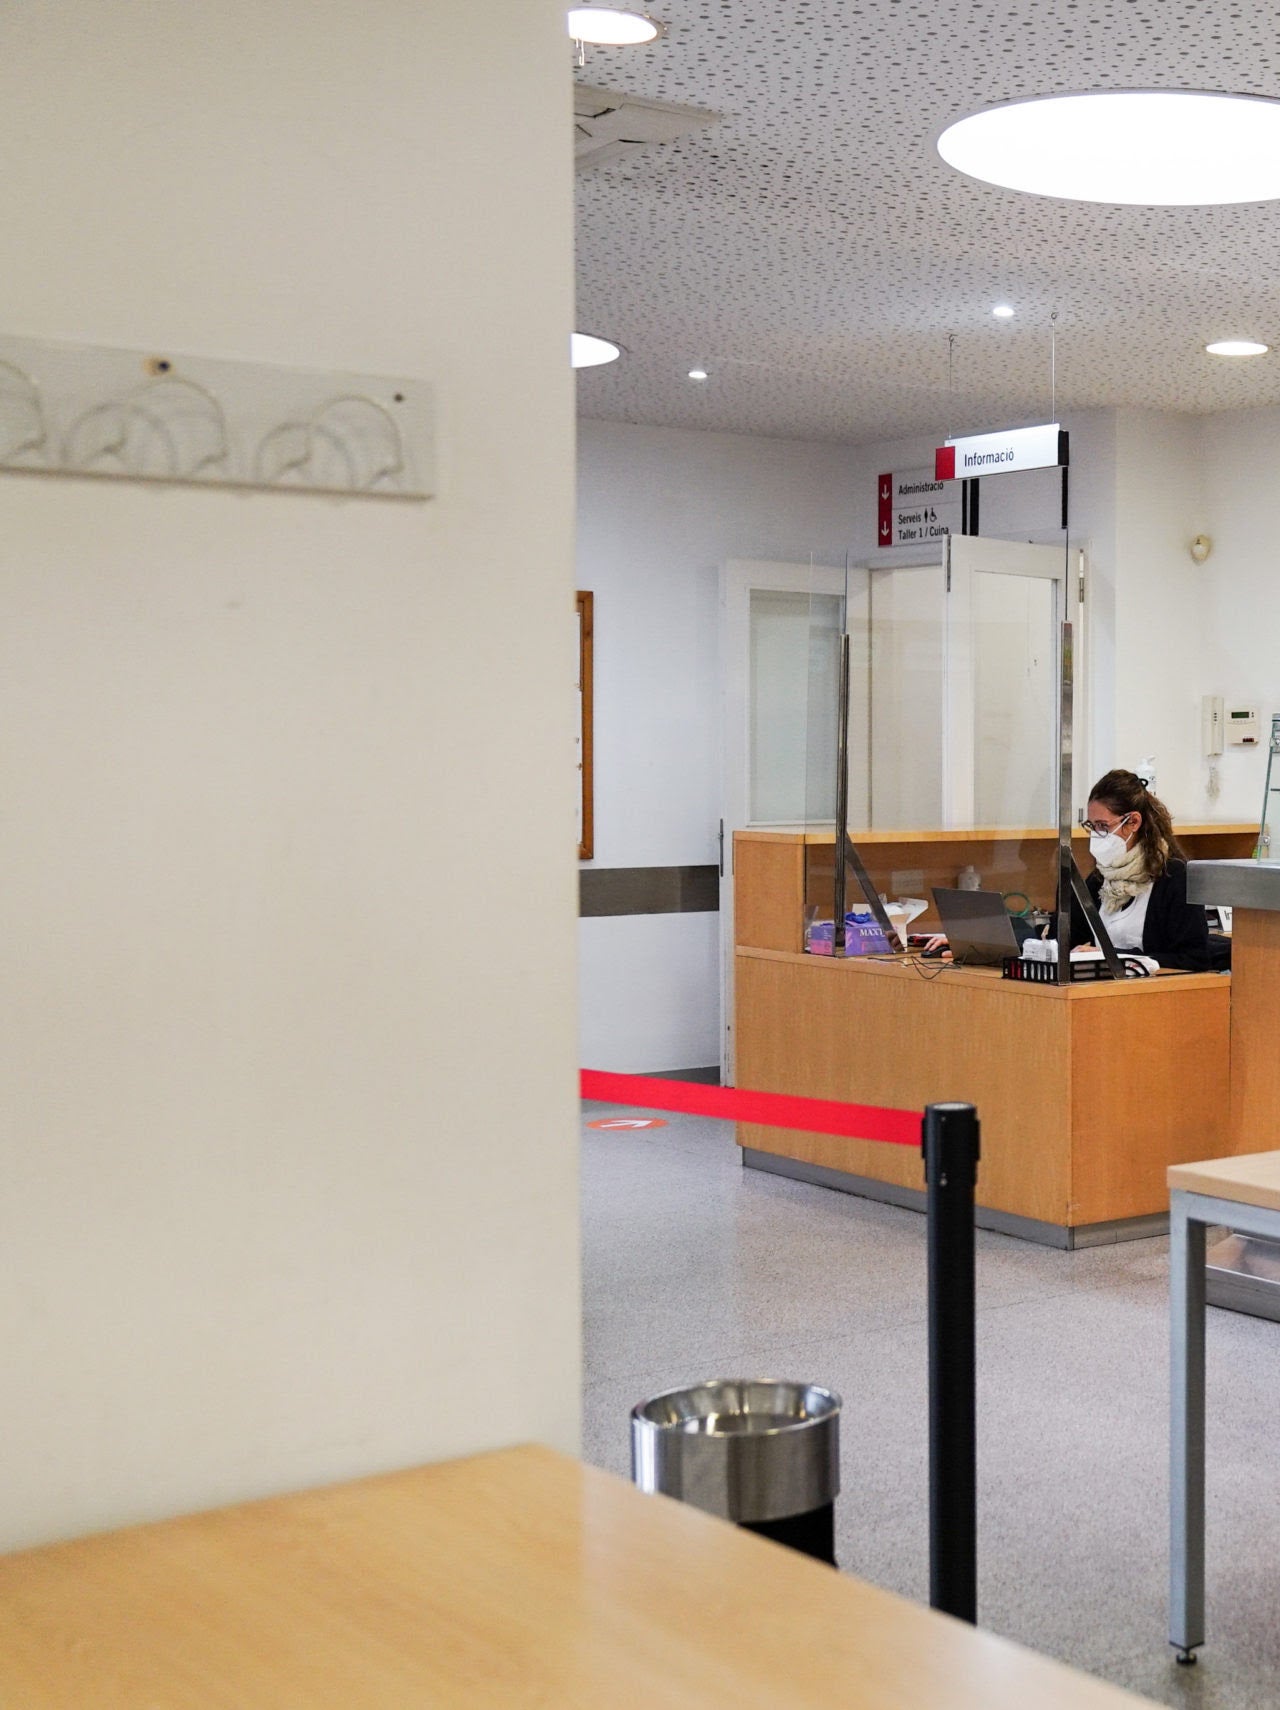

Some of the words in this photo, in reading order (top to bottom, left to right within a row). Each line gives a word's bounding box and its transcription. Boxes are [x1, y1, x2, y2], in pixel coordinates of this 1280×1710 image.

[964, 448, 1014, 467] Informació
[898, 512, 921, 525] Serveis
[898, 530, 916, 541] Taller
[919, 529, 922, 538] 1
[924, 528, 928, 538] /
[929, 526, 949, 538] Cuina
